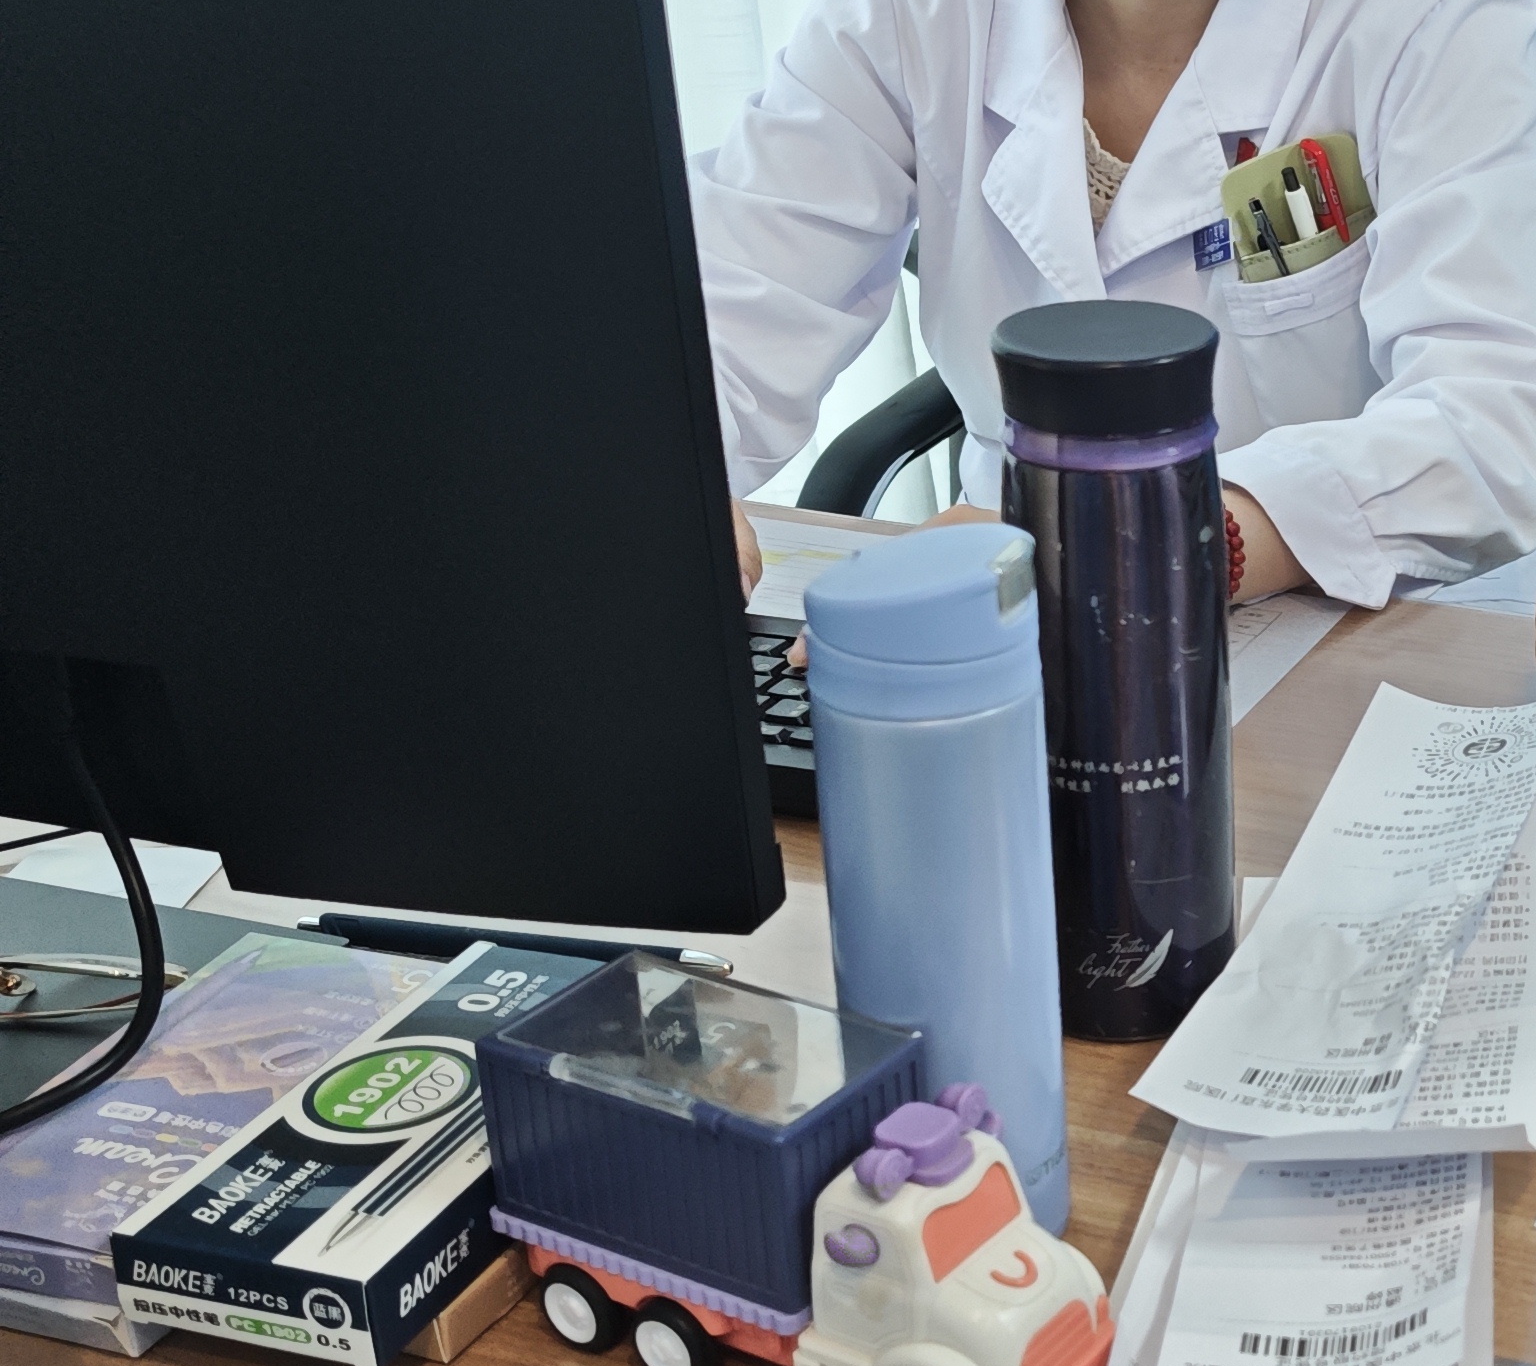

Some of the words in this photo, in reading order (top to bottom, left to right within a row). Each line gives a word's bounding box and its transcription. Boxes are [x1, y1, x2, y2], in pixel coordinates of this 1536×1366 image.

[457, 969, 528, 1013] 0.5
[333, 1056, 423, 1118] 1902
[72, 1136, 205, 1184] Cream
[191, 1163, 273, 1225] BAOKE
[229, 1159, 322, 1234] RETRACTABLE
[132, 1259, 202, 1294] BAOKE
[227, 1286, 290, 1311] 12PCS
[399, 1238, 458, 1318] BAOKE
[133, 1297, 220, 1327] 按压中性笔
[229, 1317, 256, 1333] PC
[316, 1333, 352, 1352] 0.5
